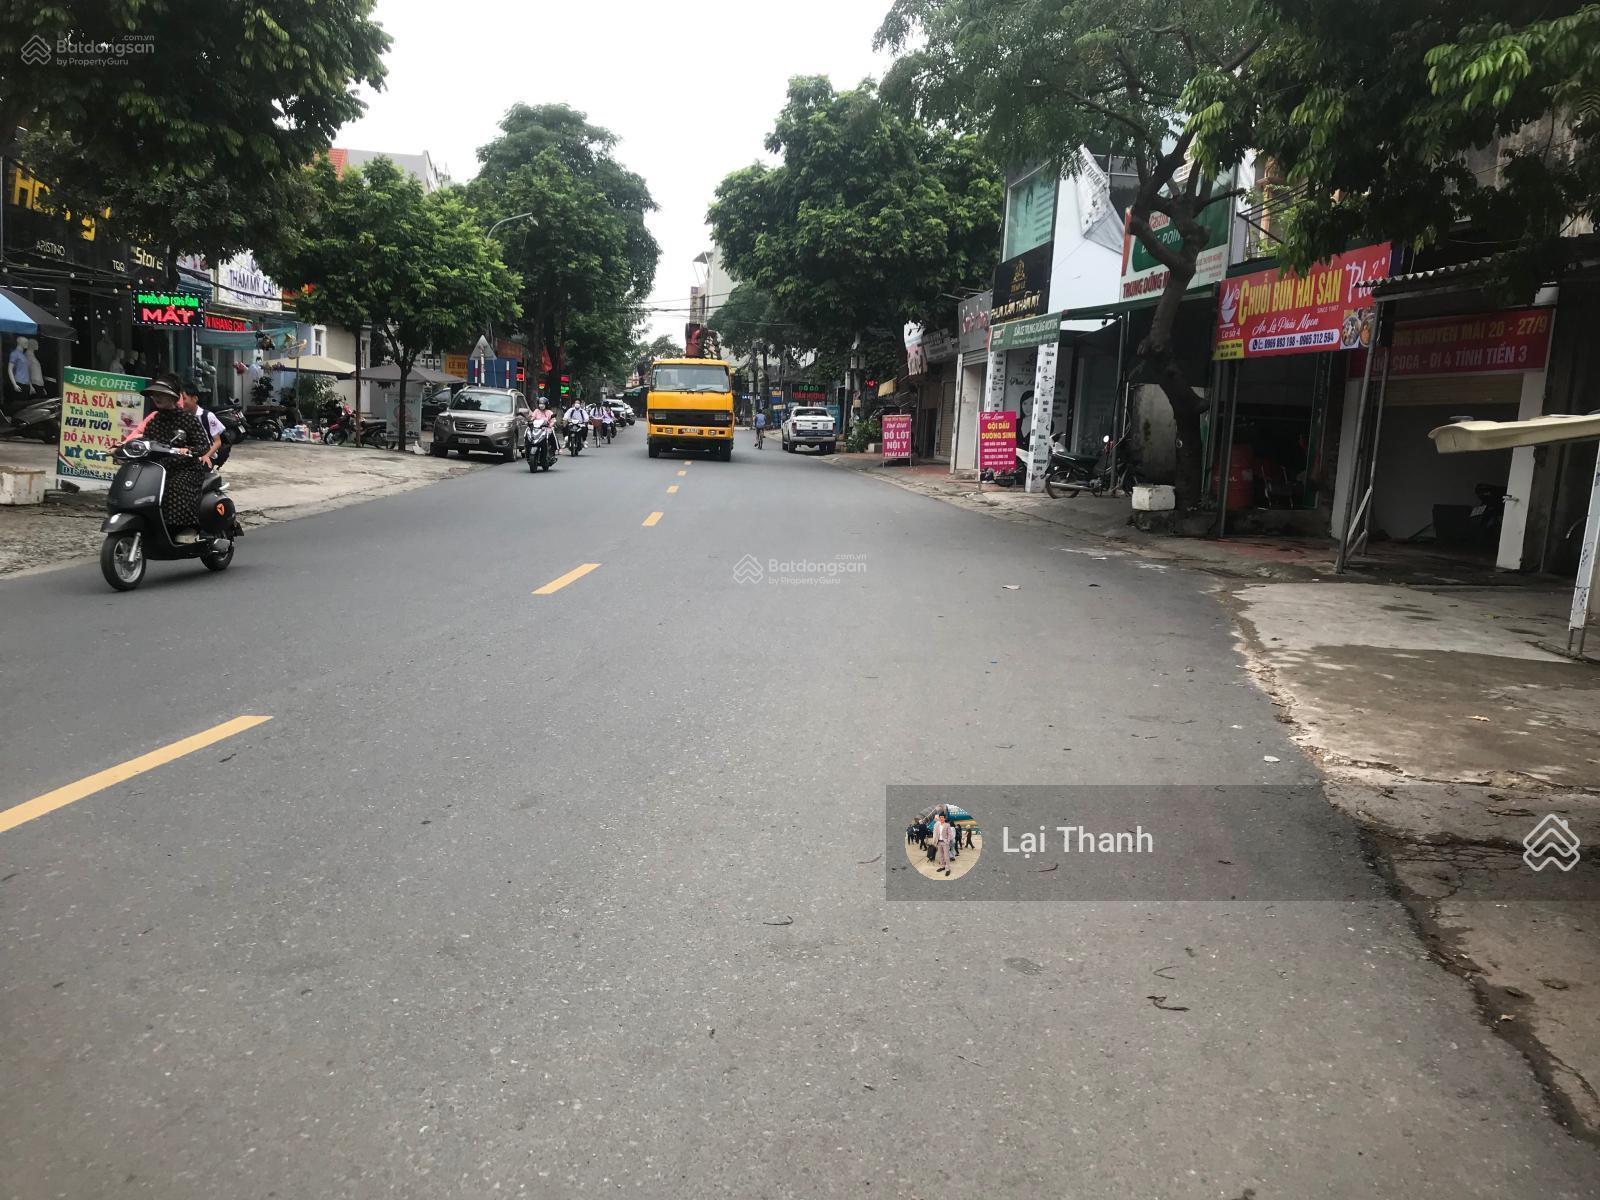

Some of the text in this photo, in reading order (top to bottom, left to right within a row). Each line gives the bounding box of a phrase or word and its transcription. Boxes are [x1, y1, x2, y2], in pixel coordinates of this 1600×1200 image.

[1518, 345, 1527, 362] 3
[72, 374, 138, 391] 1986 COFFEE
[66, 390, 114, 408] TRÀ SỮA
[70, 406, 109, 418] Trà chanh
[65, 417, 86, 428] KEM
[902, 441, 907, 449] Y
